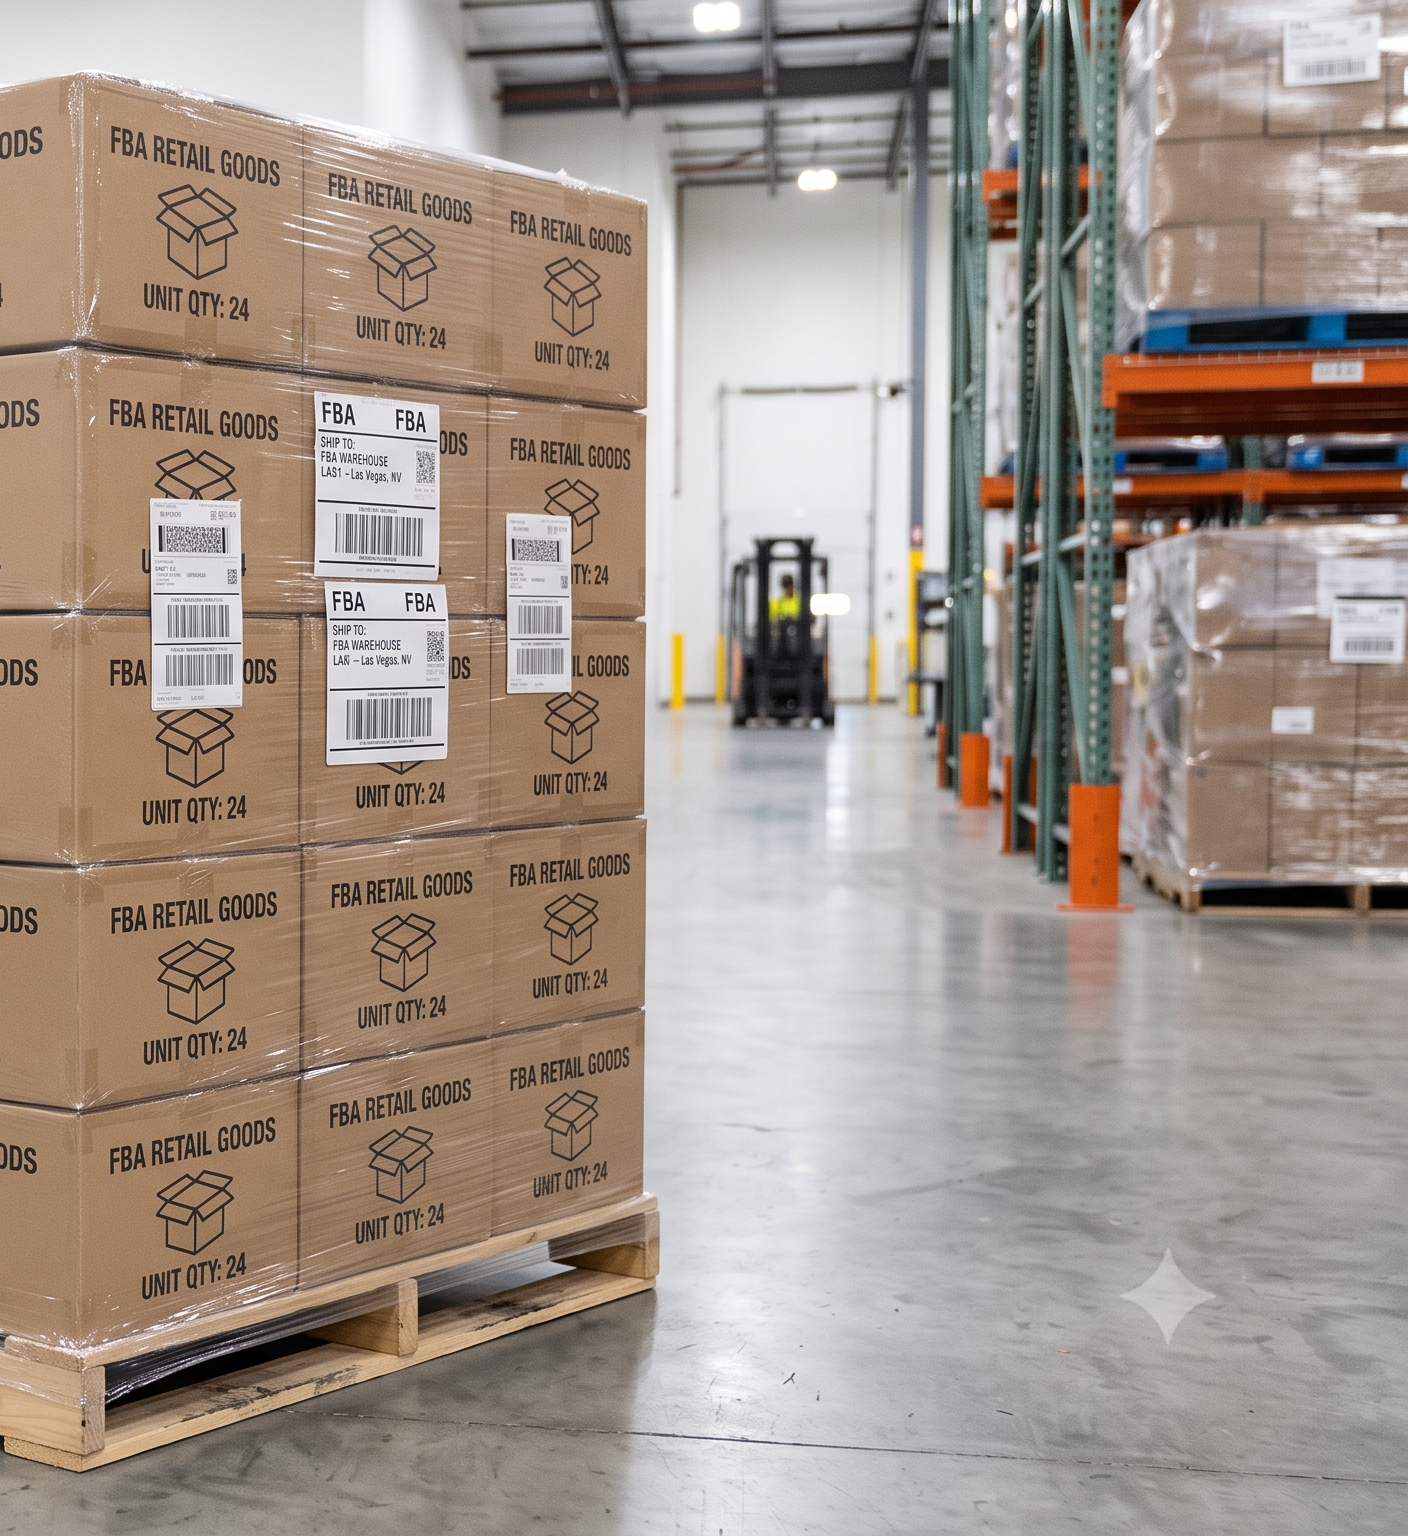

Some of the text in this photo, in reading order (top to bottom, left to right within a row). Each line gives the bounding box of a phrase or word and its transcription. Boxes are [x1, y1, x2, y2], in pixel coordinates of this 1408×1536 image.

[110, 125, 281, 187] FBA RETAIL GOODS
[328, 172, 473, 225] FBA RETAIL GOODS
[510, 210, 632, 257] FBA RETAIL GOODS
[143, 282, 250, 322] UNIT QTY: 24
[109, 398, 279, 442] FBA RETAIL GOODS
[321, 401, 356, 426] FBA
[395, 408, 427, 433] FBA
[320, 436, 356, 451] SHIP TO:
[320, 450, 389, 468] FBA WAREHOUSE
[439, 429, 468, 457] ODS
[510, 437, 631, 471] FBA RETAIL GOODS
[321, 466, 342, 479] LAS1
[351, 468, 364, 481] Las
[365, 470, 389, 484] Vegas,
[391, 471, 402, 483] NV
[570, 563, 592, 585] TY:
[594, 564, 609, 586] 24
[332, 590, 436, 613] FBA FBA
[332, 624, 367, 636] SHIP TO:
[351, 639, 402, 651] WAREHOUSE
[109, 659, 148, 687] FBA
[242, 658, 277, 685] ODS
[361, 654, 374, 666] Las
[401, 654, 412, 665] NV
[587, 654, 630, 678] GOODS
[355, 781, 446, 809] UNIT QTY: 24
[533, 770, 608, 796] UNIT QTY: 24
[142, 794, 247, 826] UNIT QTY: 24
[509, 852, 631, 888] FBA RETAIL GOODS
[331, 870, 473, 909] FBA RETAIL GOODS
[111, 891, 278, 935] FBA RETAIL GOODS
[357, 994, 447, 1030] UNIT QTY: 24
[143, 1026, 248, 1066] UNIT QTY: 24
[510, 1046, 630, 1092] FBA RETAIL GOODS
[329, 1077, 472, 1129] FBA RETAIL GOODS
[109, 1116, 276, 1175] FBA RETAIL GOODS
[141, 1251, 247, 1300] UNIT QTY: 24
